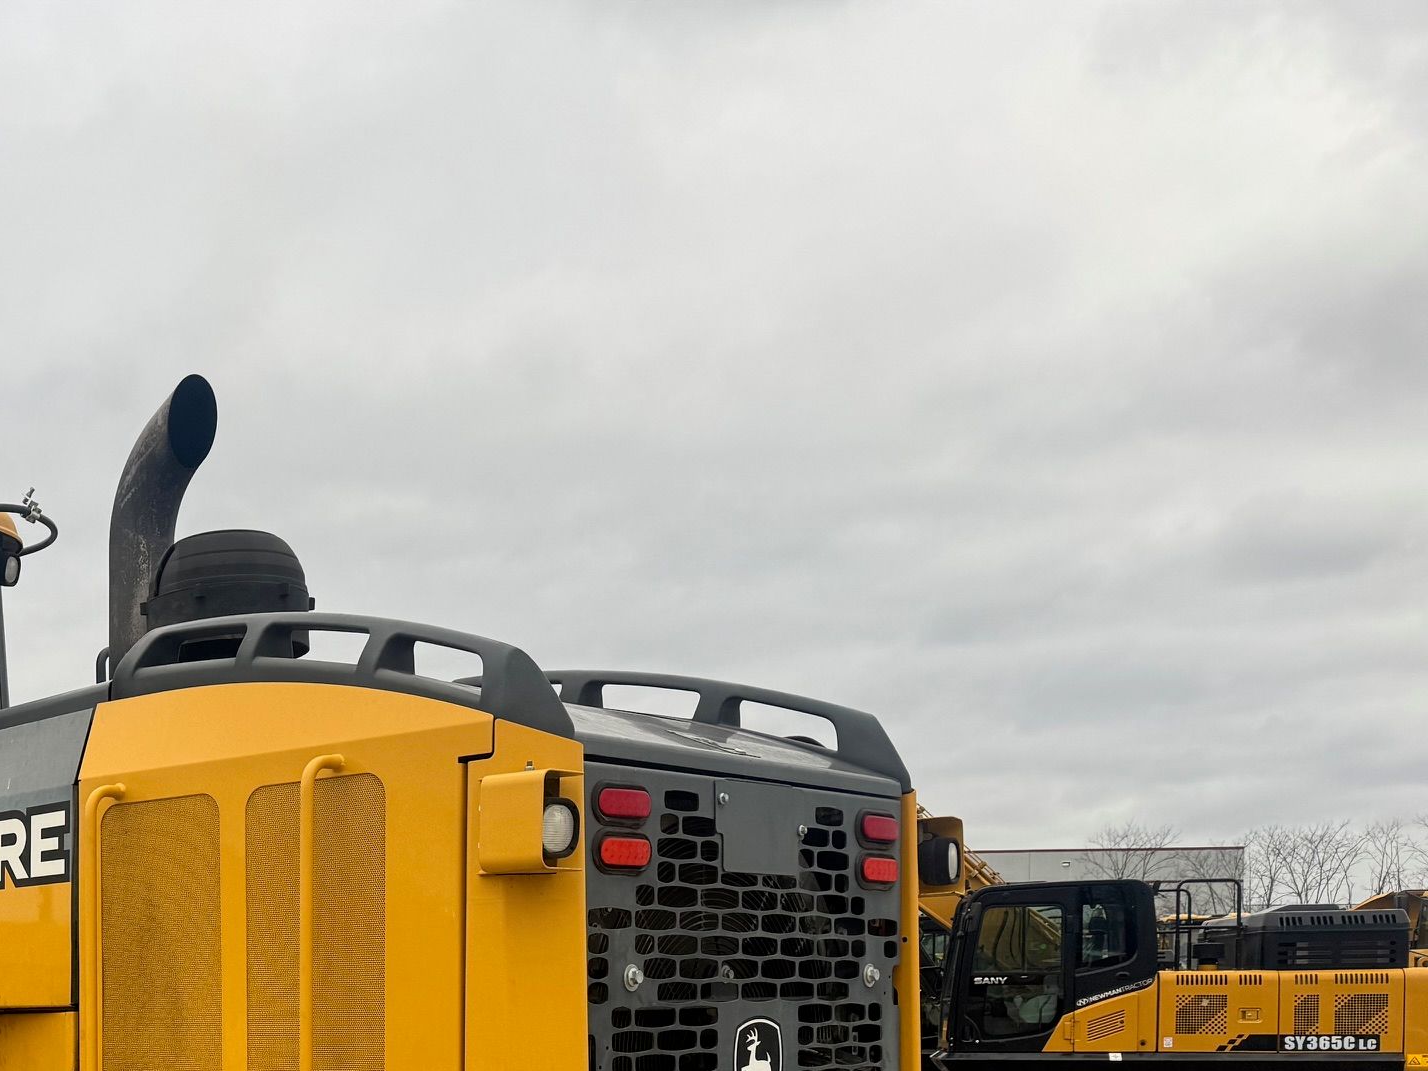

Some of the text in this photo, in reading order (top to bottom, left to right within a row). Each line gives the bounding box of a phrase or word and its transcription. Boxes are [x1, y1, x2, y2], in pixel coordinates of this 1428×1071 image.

[973, 976, 1008, 985] SANY
[1284, 1035, 1377, 1051] SY365C LC
